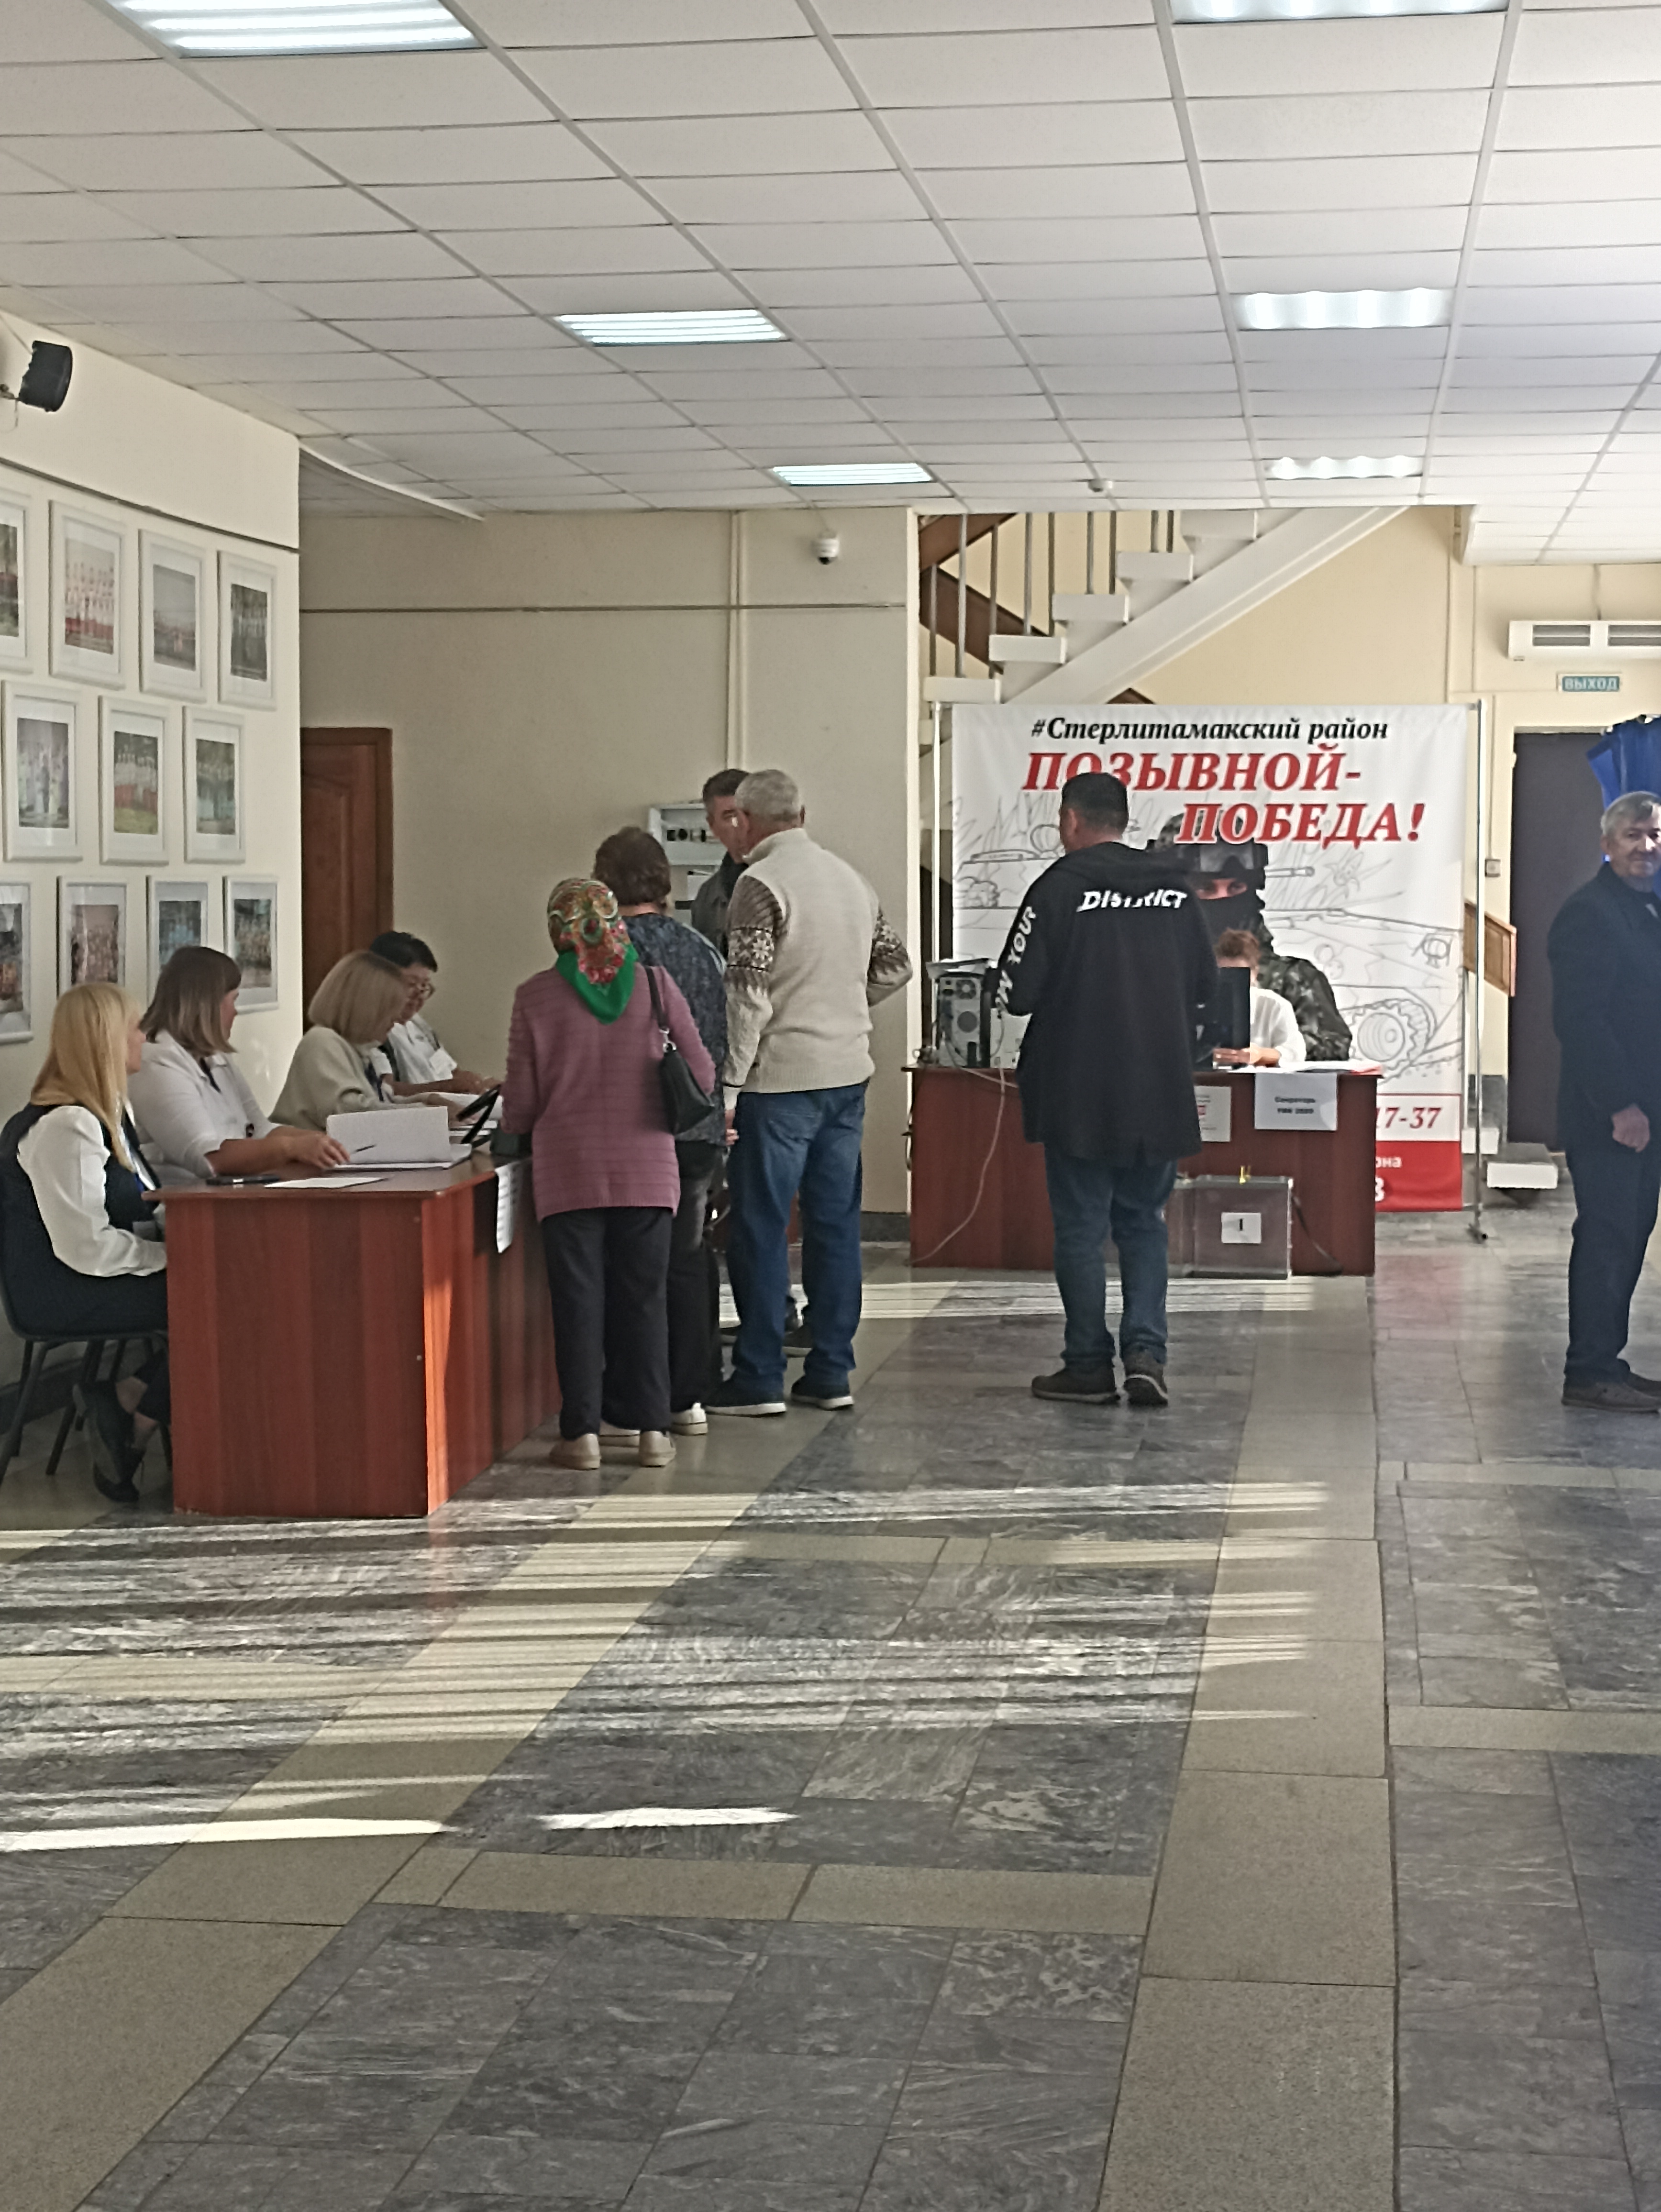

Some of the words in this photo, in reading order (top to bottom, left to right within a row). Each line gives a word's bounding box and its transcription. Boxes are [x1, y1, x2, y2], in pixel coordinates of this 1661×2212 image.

[1565, 677, 1617, 691] ВЫХОД
[1031, 717, 1300, 744] #Стерлитамакский
[1307, 717, 1388, 744] район
[1021, 743, 1361, 791] ПОЗЫВНОЙ-
[1174, 803, 1426, 849] ПОБЕДА!
